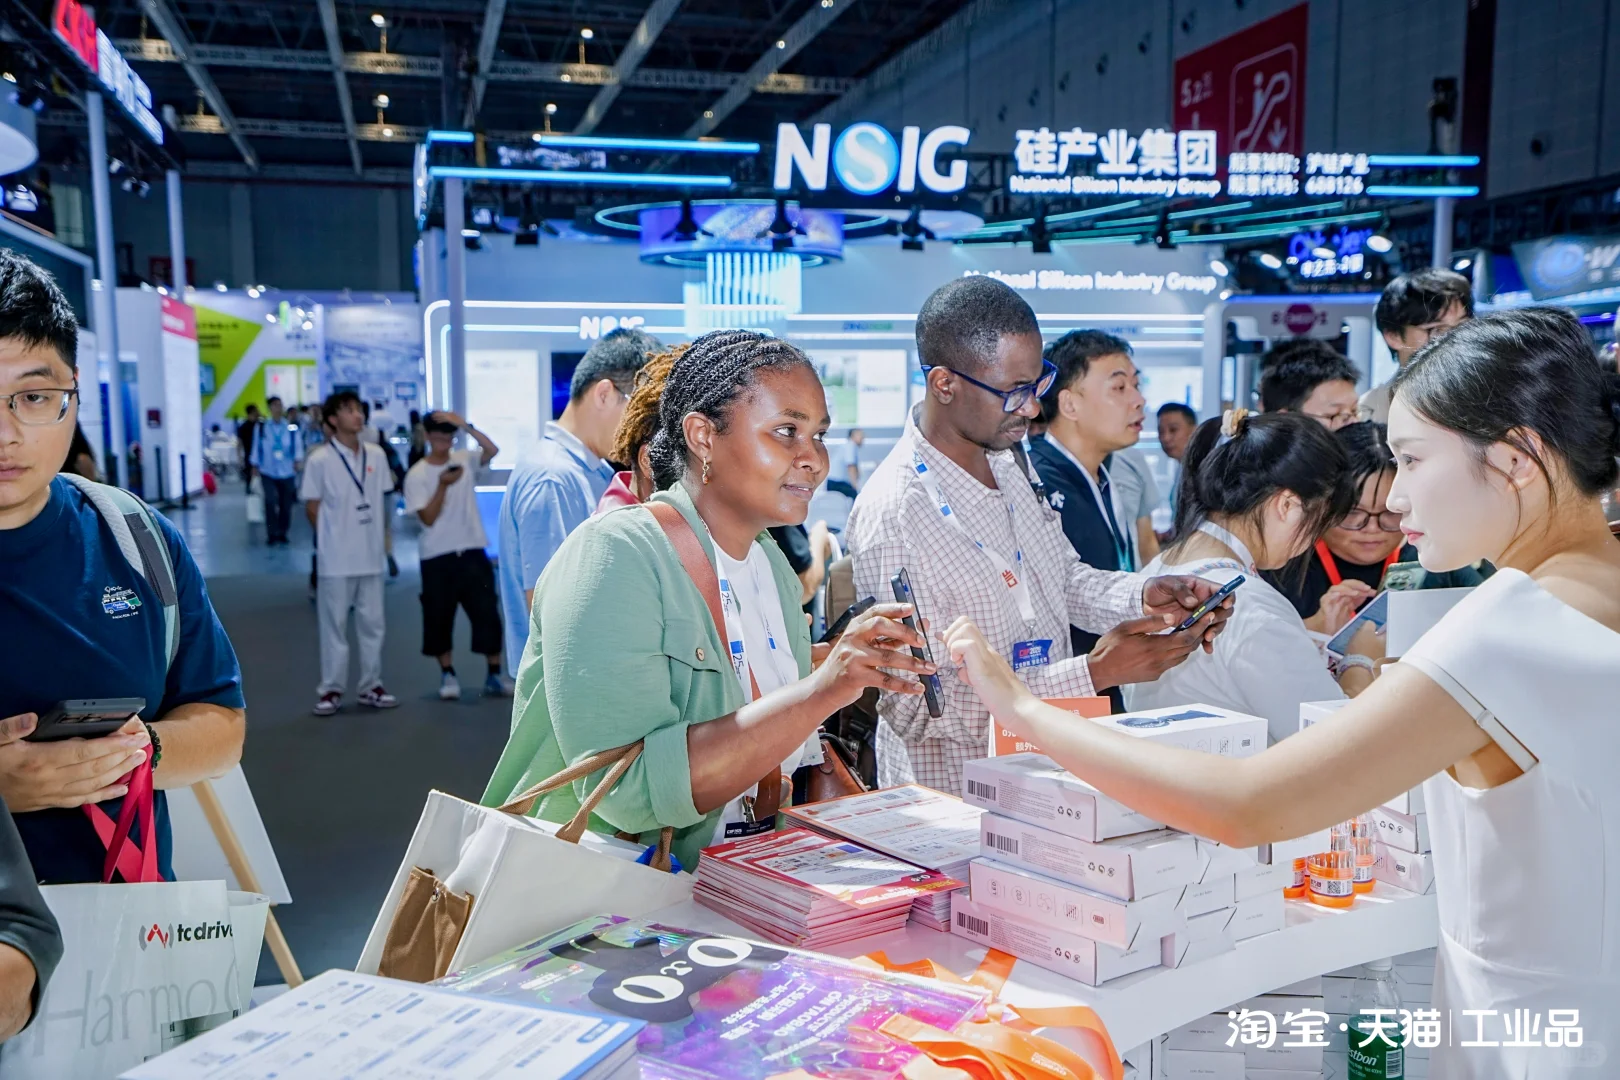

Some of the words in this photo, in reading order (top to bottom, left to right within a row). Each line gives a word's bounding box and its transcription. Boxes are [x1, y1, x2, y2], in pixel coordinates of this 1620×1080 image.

[773, 121, 971, 195] NSIG
[1014, 127, 1217, 176] 硅产业集团
[1009, 174, 1071, 193] National
[1072, 176, 1118, 194] Silicon
[1119, 177, 1177, 197] Industry
[1177, 177, 1221, 198] Group
[963, 270, 1036, 289] ional
[1038, 270, 1094, 290] Silicon
[1095, 271, 1165, 294] Industry
[1166, 271, 1217, 295] Group
[177, 924, 191, 941] tc
[773, 1003, 827, 1037] TAOBAO
